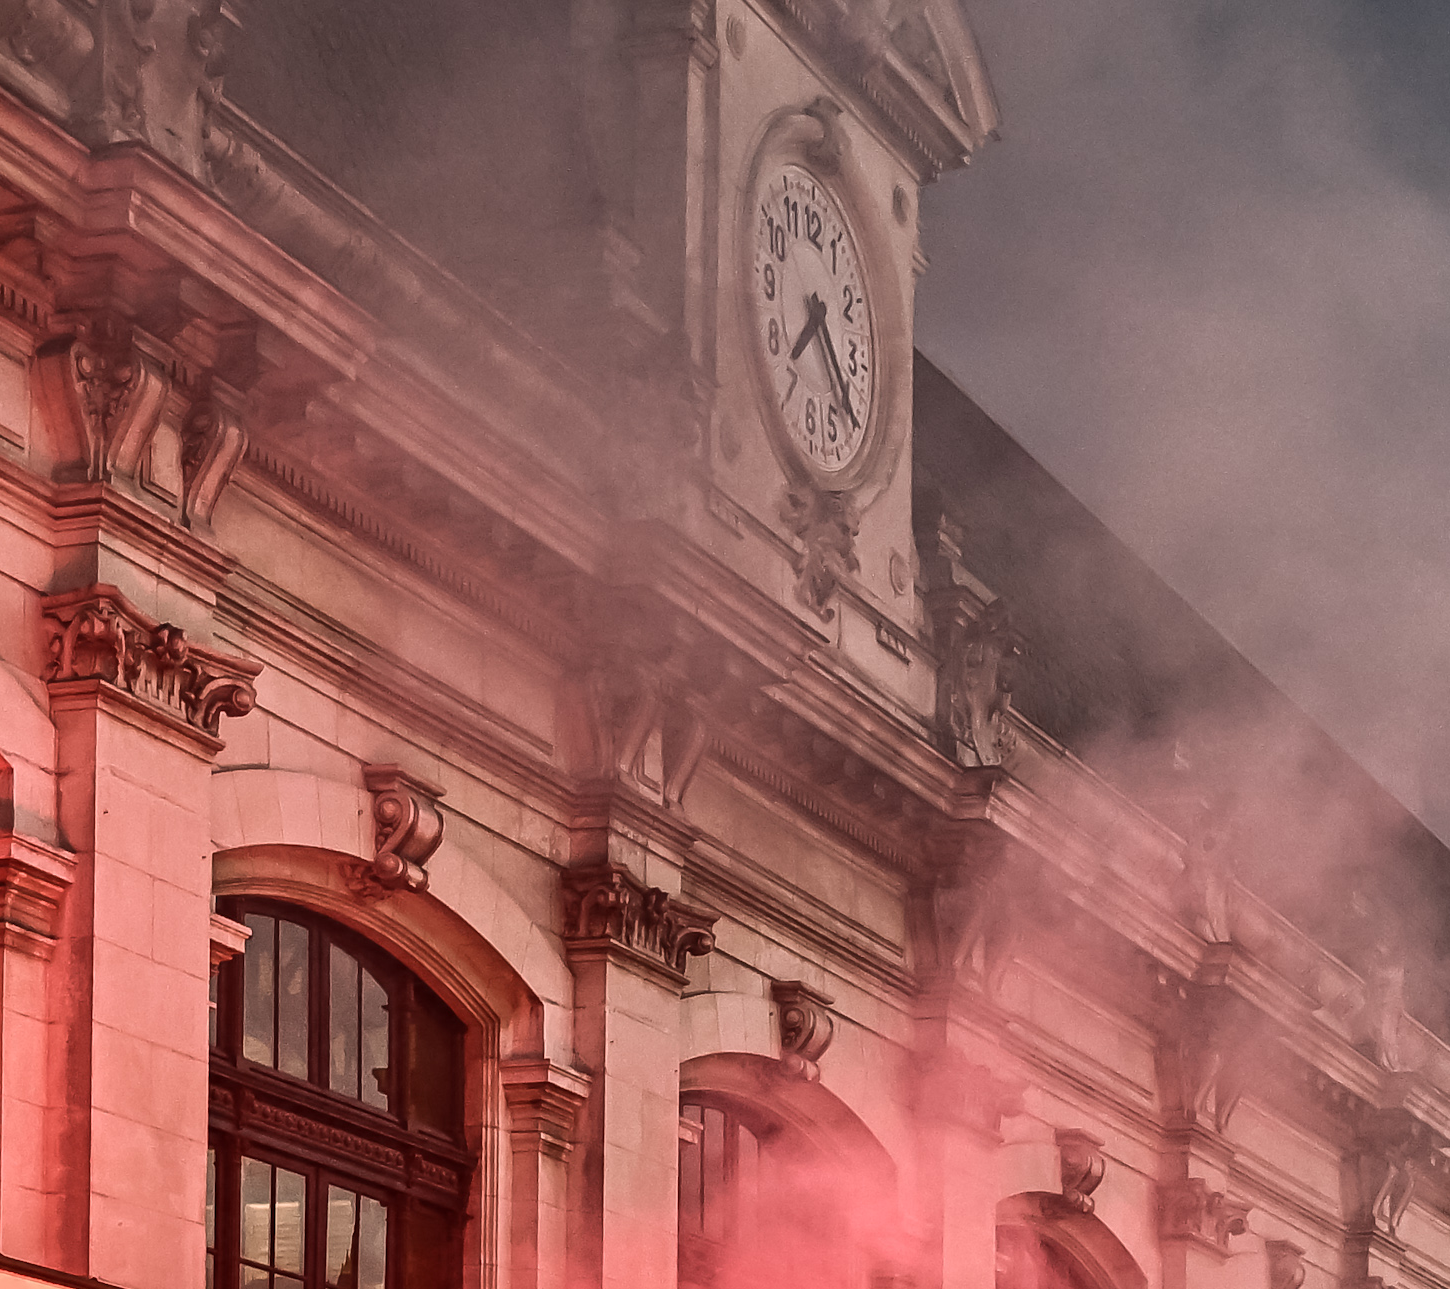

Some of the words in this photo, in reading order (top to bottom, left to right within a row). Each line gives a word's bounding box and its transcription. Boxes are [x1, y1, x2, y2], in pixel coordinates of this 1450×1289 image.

[783, 196, 799, 239] 11
[805, 205, 823, 252] 12
[767, 217, 785, 262] 10
[829, 240, 838, 275] 1
[764, 264, 775, 301] 9
[843, 287, 854, 323] 2
[768, 318, 780, 355] 8
[847, 340, 858, 377] 3
[782, 367, 798, 410] 7
[804, 397, 816, 435] 6
[827, 401, 838, 442] 5
